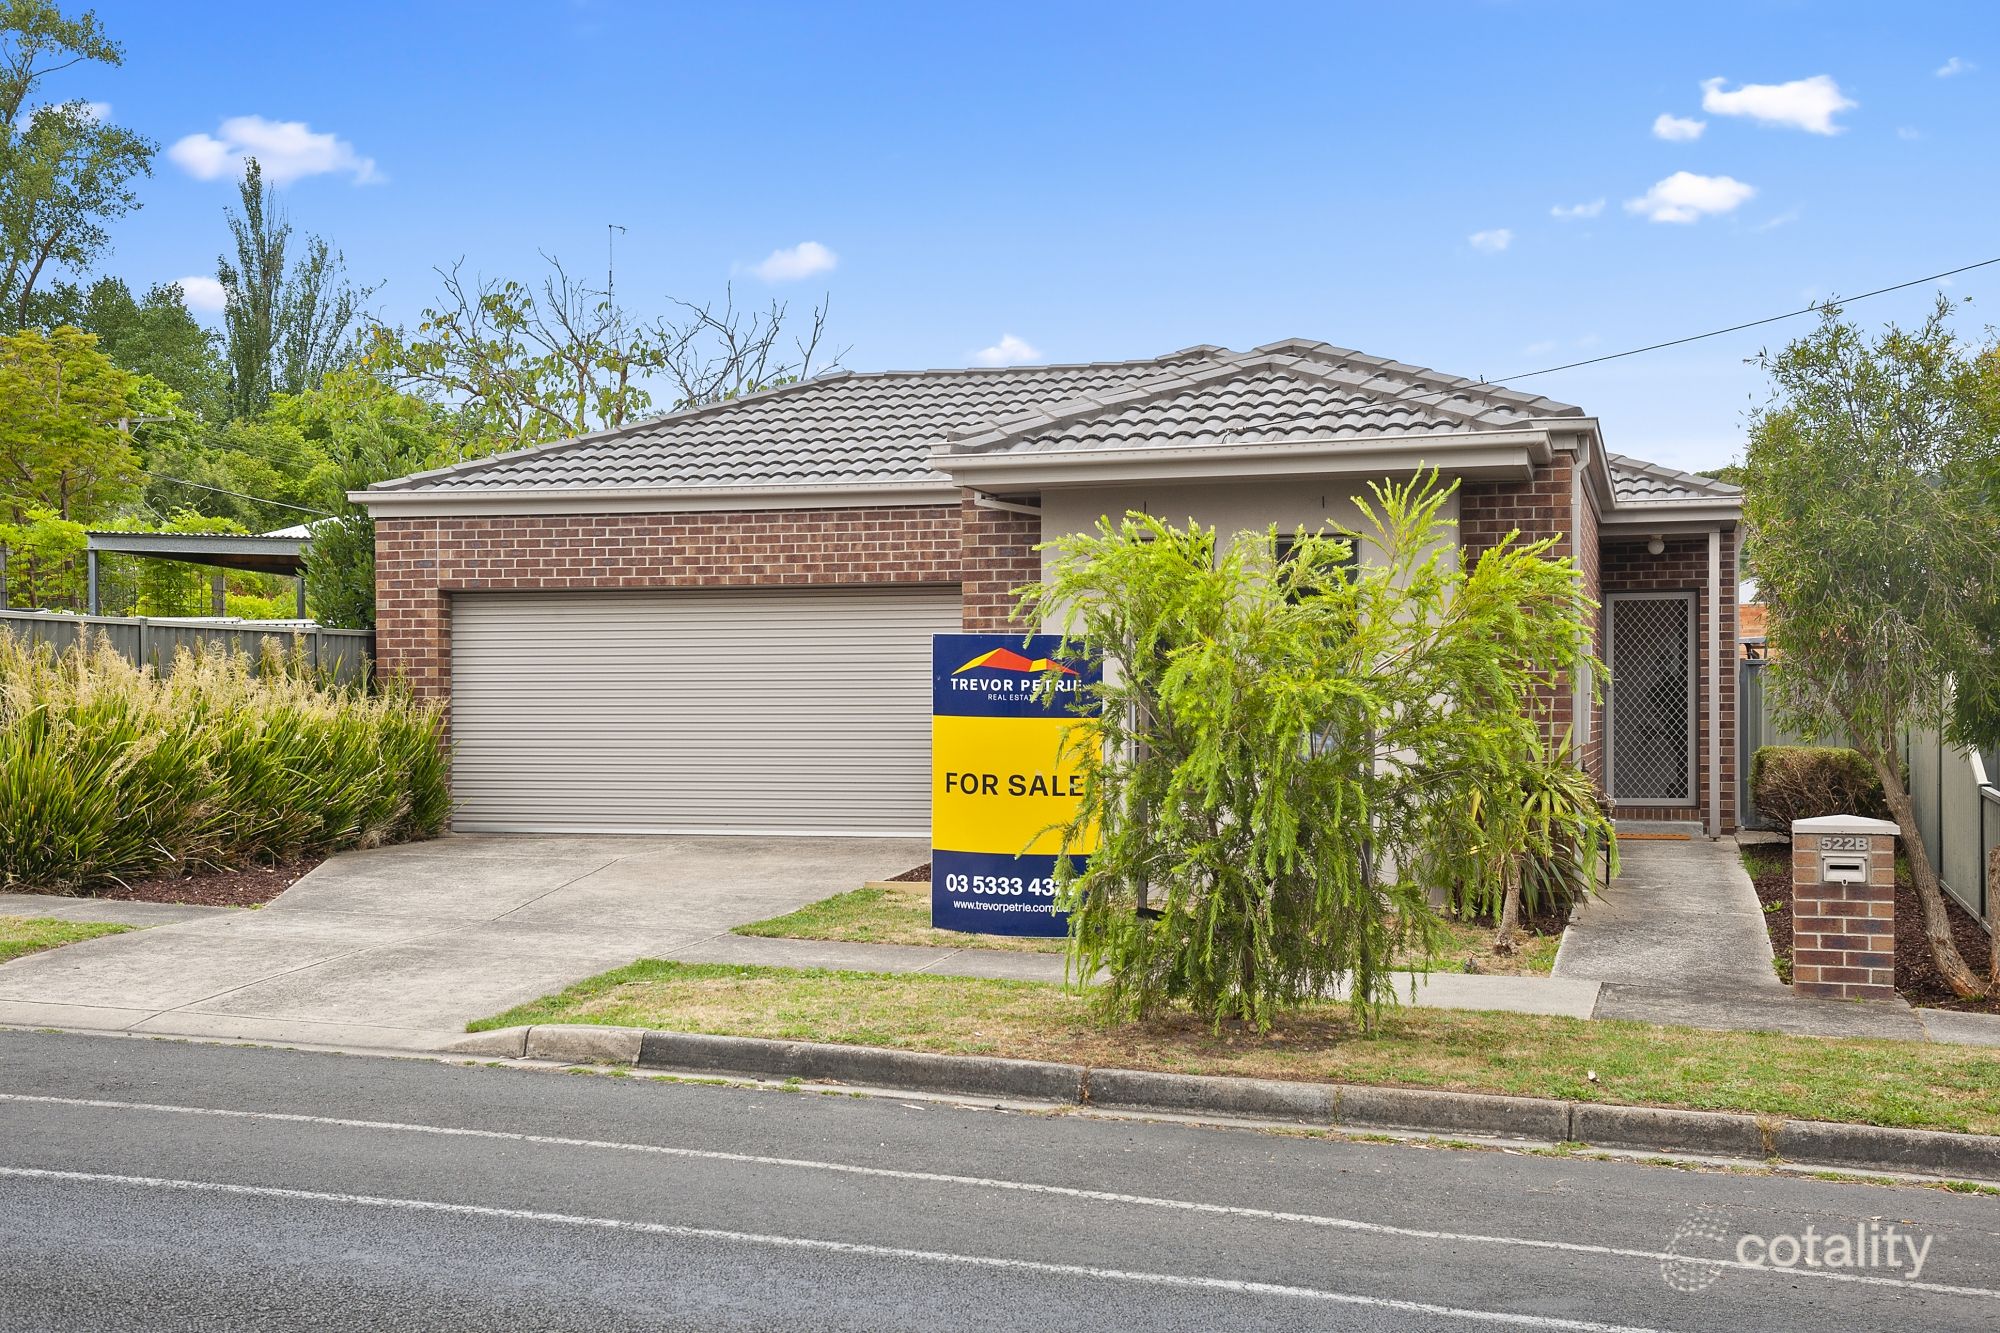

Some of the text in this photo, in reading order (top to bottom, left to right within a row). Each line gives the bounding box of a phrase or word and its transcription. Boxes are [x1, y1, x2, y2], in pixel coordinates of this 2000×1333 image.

[950, 678, 1014, 691] TREVOR
[987, 693, 1007, 701] REAL
[945, 772, 1084, 797] FOR SALE
[1821, 837, 1868, 851] 522B
[945, 873, 1080, 897] 03 5333 43
